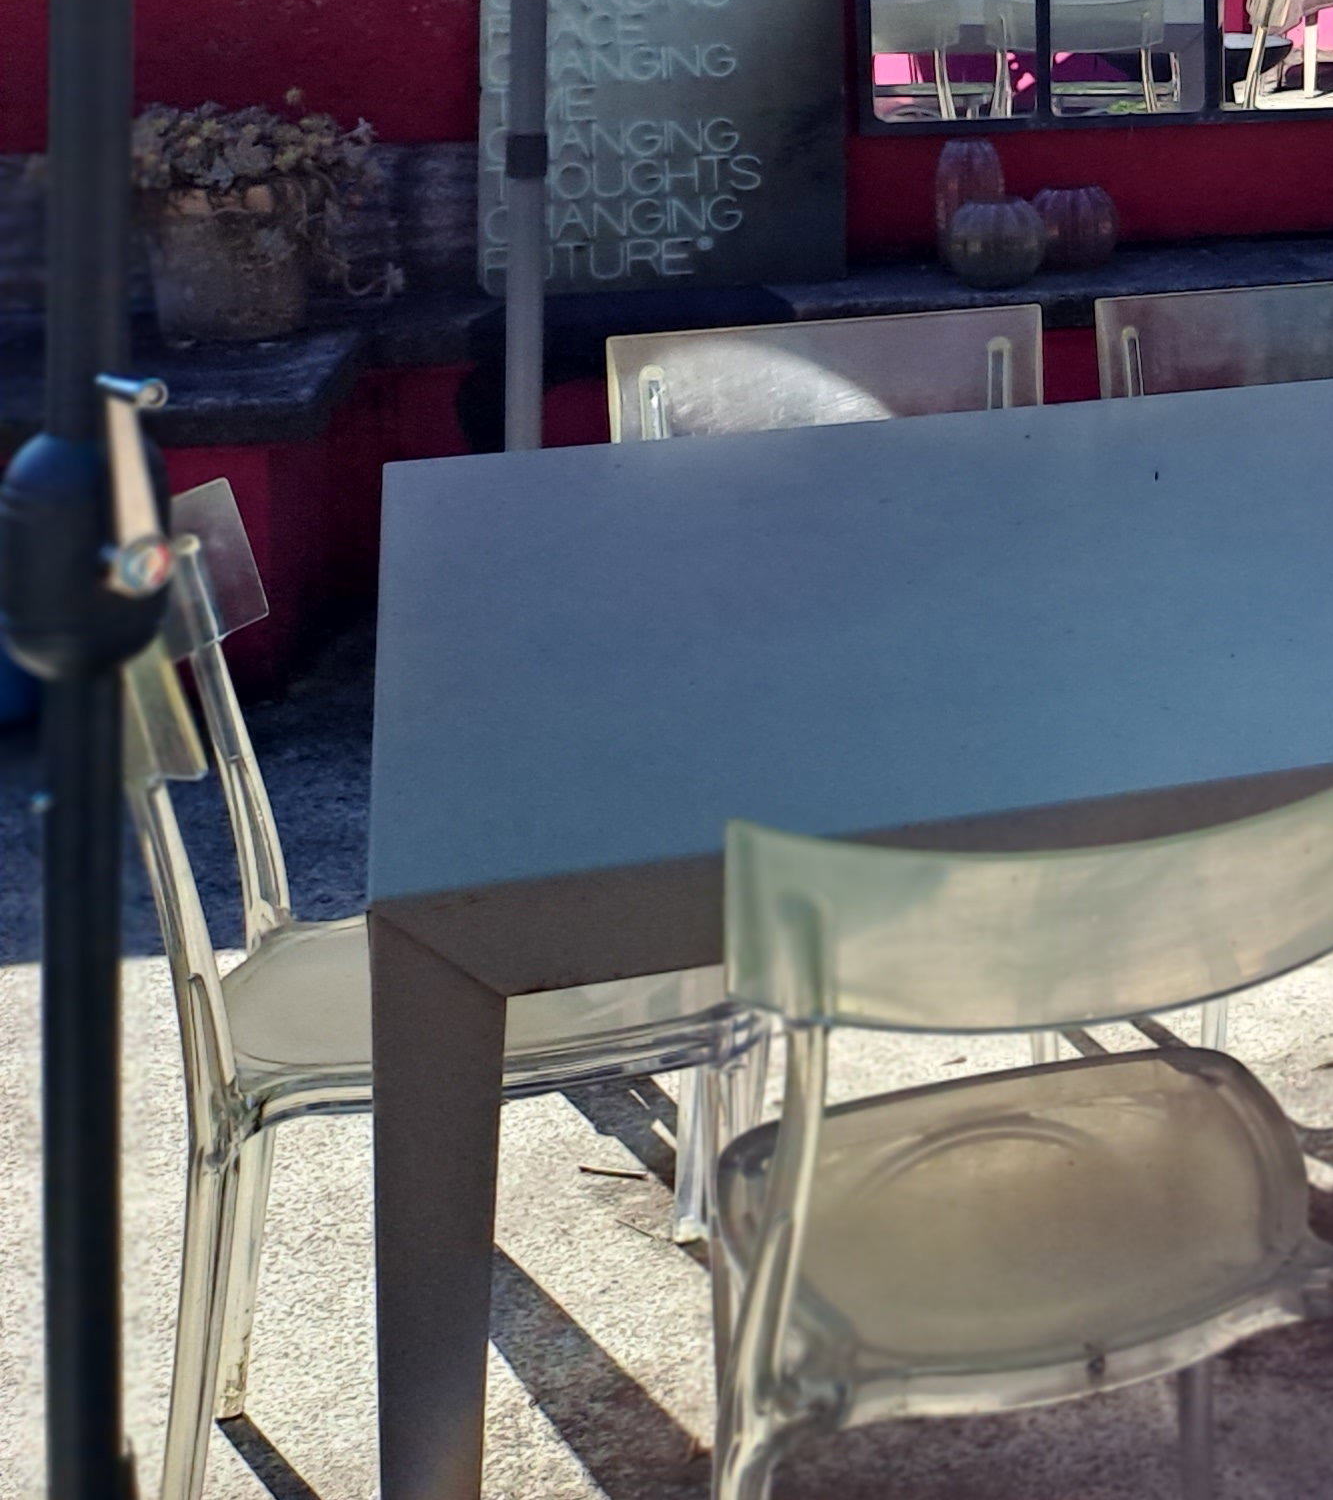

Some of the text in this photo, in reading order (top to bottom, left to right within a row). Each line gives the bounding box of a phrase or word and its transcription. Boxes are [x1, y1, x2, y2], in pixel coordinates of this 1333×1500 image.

[487, 11, 650, 52] PACE
[487, 44, 738, 86] CANGING
[486, 117, 741, 164] CANGING
[484, 155, 763, 201] TOUGHTS
[483, 195, 744, 244] CANGING
